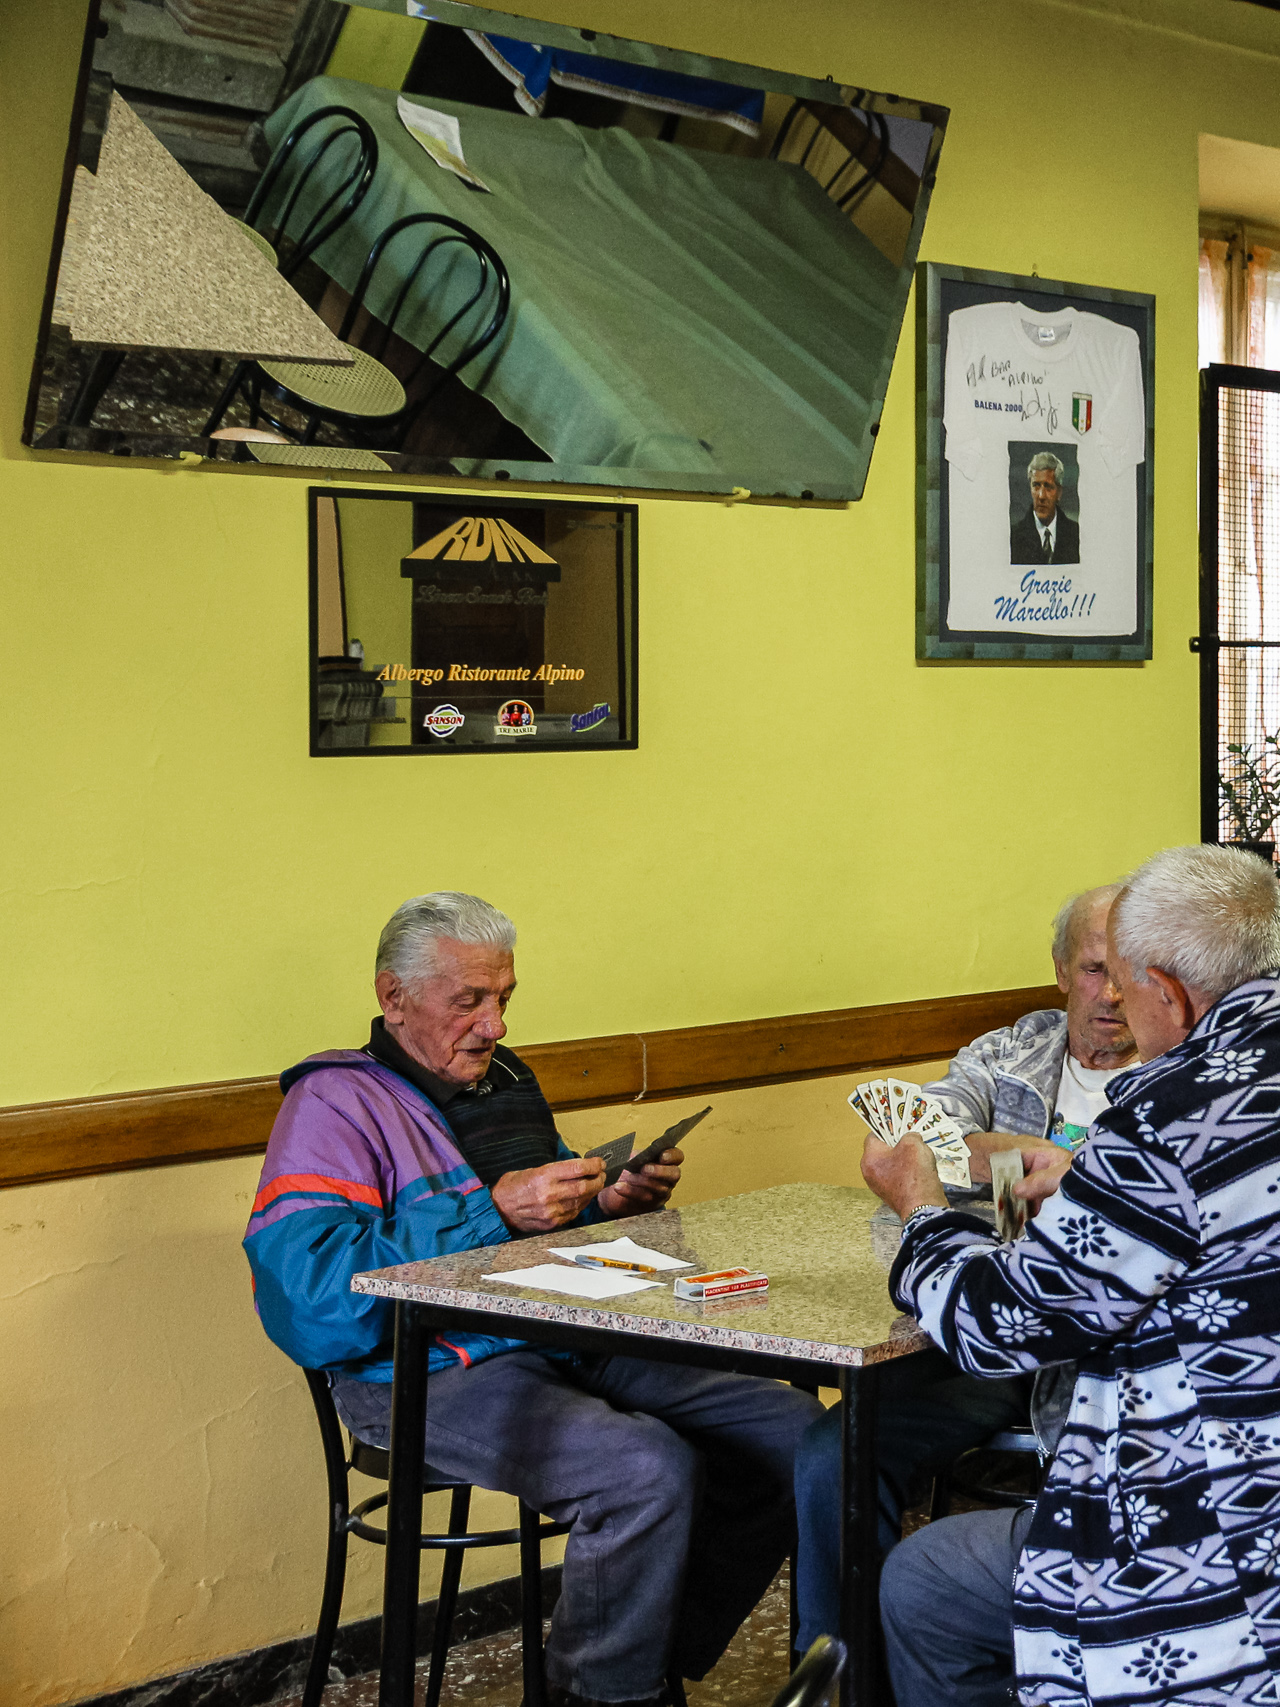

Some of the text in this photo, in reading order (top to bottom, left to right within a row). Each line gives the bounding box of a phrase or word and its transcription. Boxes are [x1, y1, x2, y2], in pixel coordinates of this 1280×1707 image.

[974, 399, 1023, 413] BALENA 2000
[405, 516, 559, 564] RDM
[1020, 569, 1073, 603] Grazie
[994, 593, 1097, 622] Marcello!!!
[377, 664, 586, 686] Albergo Ristorante Alpino
[426, 715, 464, 726] SANSON
[498, 726, 534, 734] TRE MARIE
